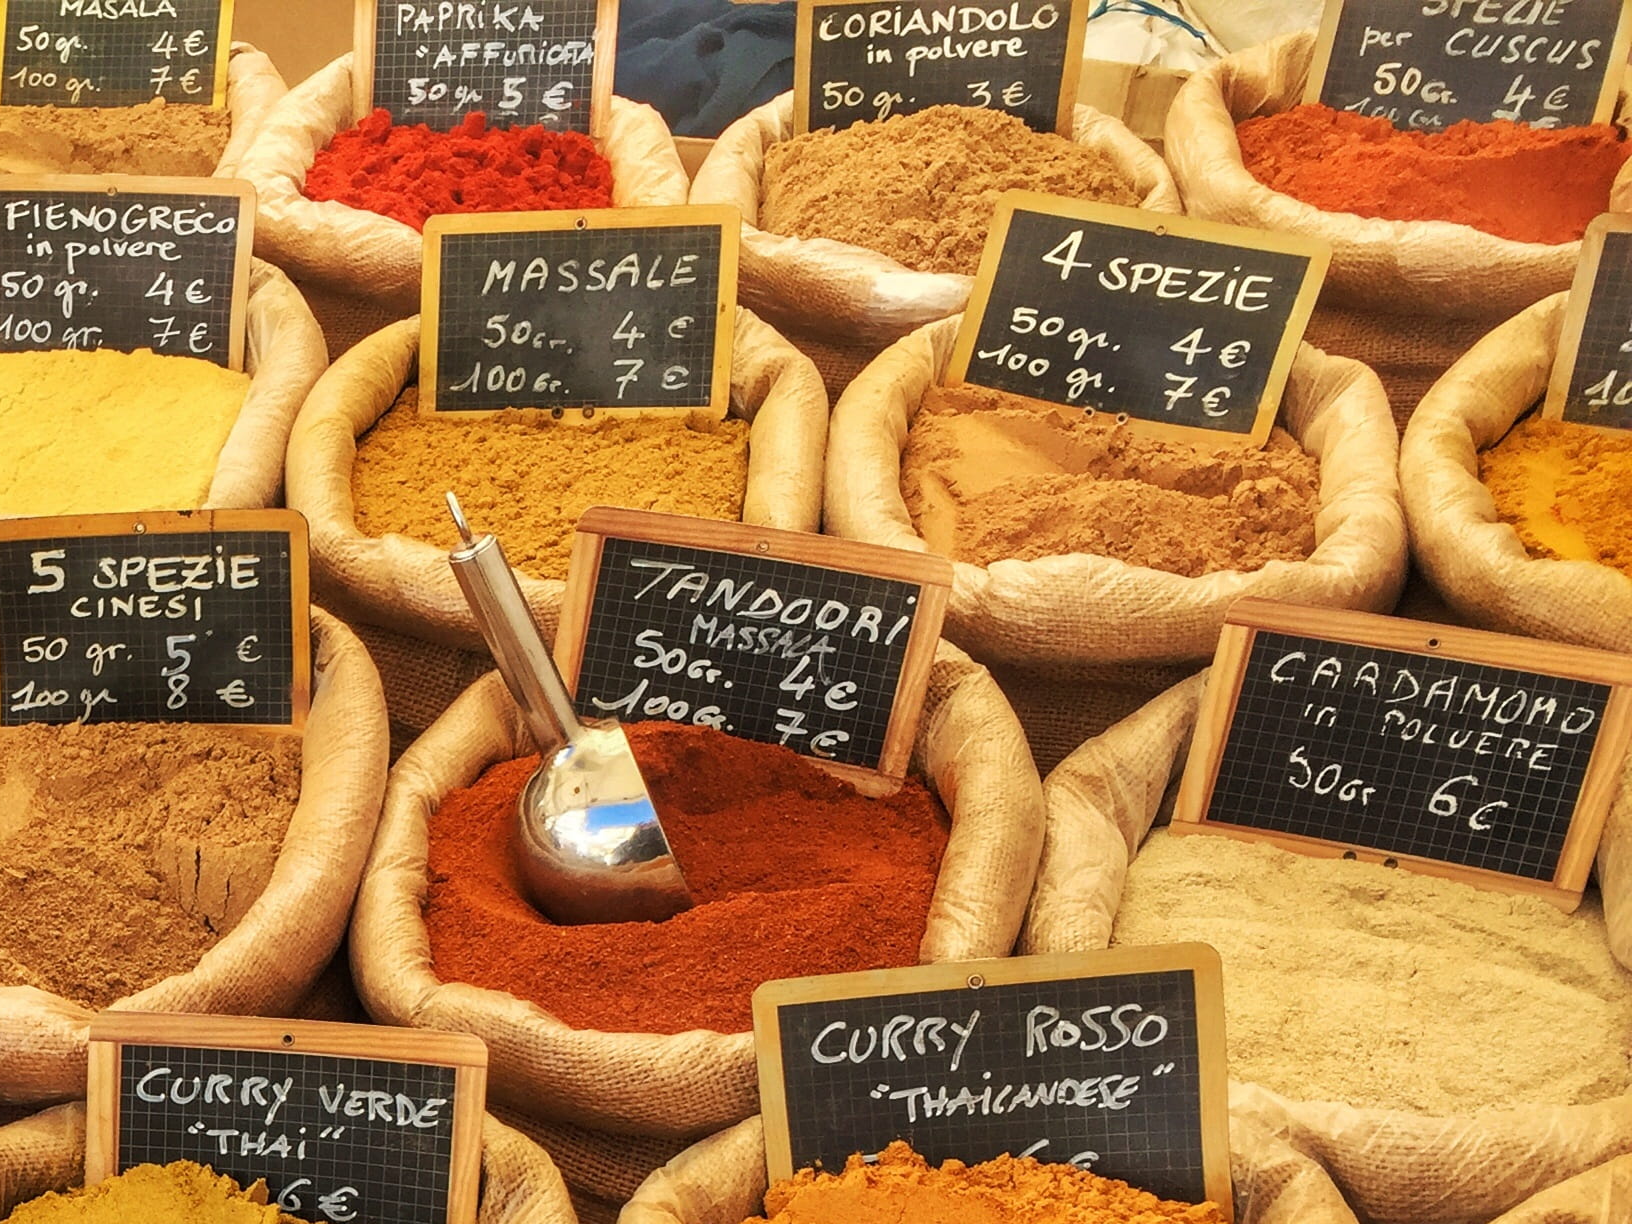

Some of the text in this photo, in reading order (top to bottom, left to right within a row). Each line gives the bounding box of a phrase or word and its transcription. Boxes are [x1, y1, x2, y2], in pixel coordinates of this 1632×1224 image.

[59, 0, 177, 19] MASALA
[819, 2, 1060, 42] CORIANDOLO
[16, 25, 50, 52] 50
[867, 36, 1029, 78] in polvere
[1359, 26, 1601, 70] per CUSCUS
[9, 66, 57, 89] 100
[407, 76, 527, 109] 50 5
[822, 81, 865, 111] 50
[1373, 62, 1422, 96] 50
[26, 233, 183, 276] in polvere
[480, 252, 700, 297] MASSALE
[1041, 230, 1274, 313] 4 SPEZIE
[0, 270, 45, 300] 50
[144, 271, 175, 307] 4
[147, 316, 181, 348] 7
[612, 311, 646, 349] 4
[1009, 306, 1065, 337] 50
[1169, 327, 1212, 366] 4
[449, 358, 645, 399] 100 7
[977, 343, 1051, 378] 100
[1163, 372, 1198, 411] 7
[27, 545, 262, 595] 5 SPEZIE
[69, 593, 202, 621] CINESI
[630, 558, 918, 646] TANDOORI
[21, 635, 69, 663] 50
[160, 633, 197, 677] 5
[10, 680, 70, 713] 100
[167, 673, 191, 711] 8
[1270, 650, 1596, 735] CARDAMOMO
[809, 1003, 1169, 1072] CURRY ROSSO
[135, 1067, 448, 1129] CURRY VERDE
[276, 1177, 312, 1212] 6
